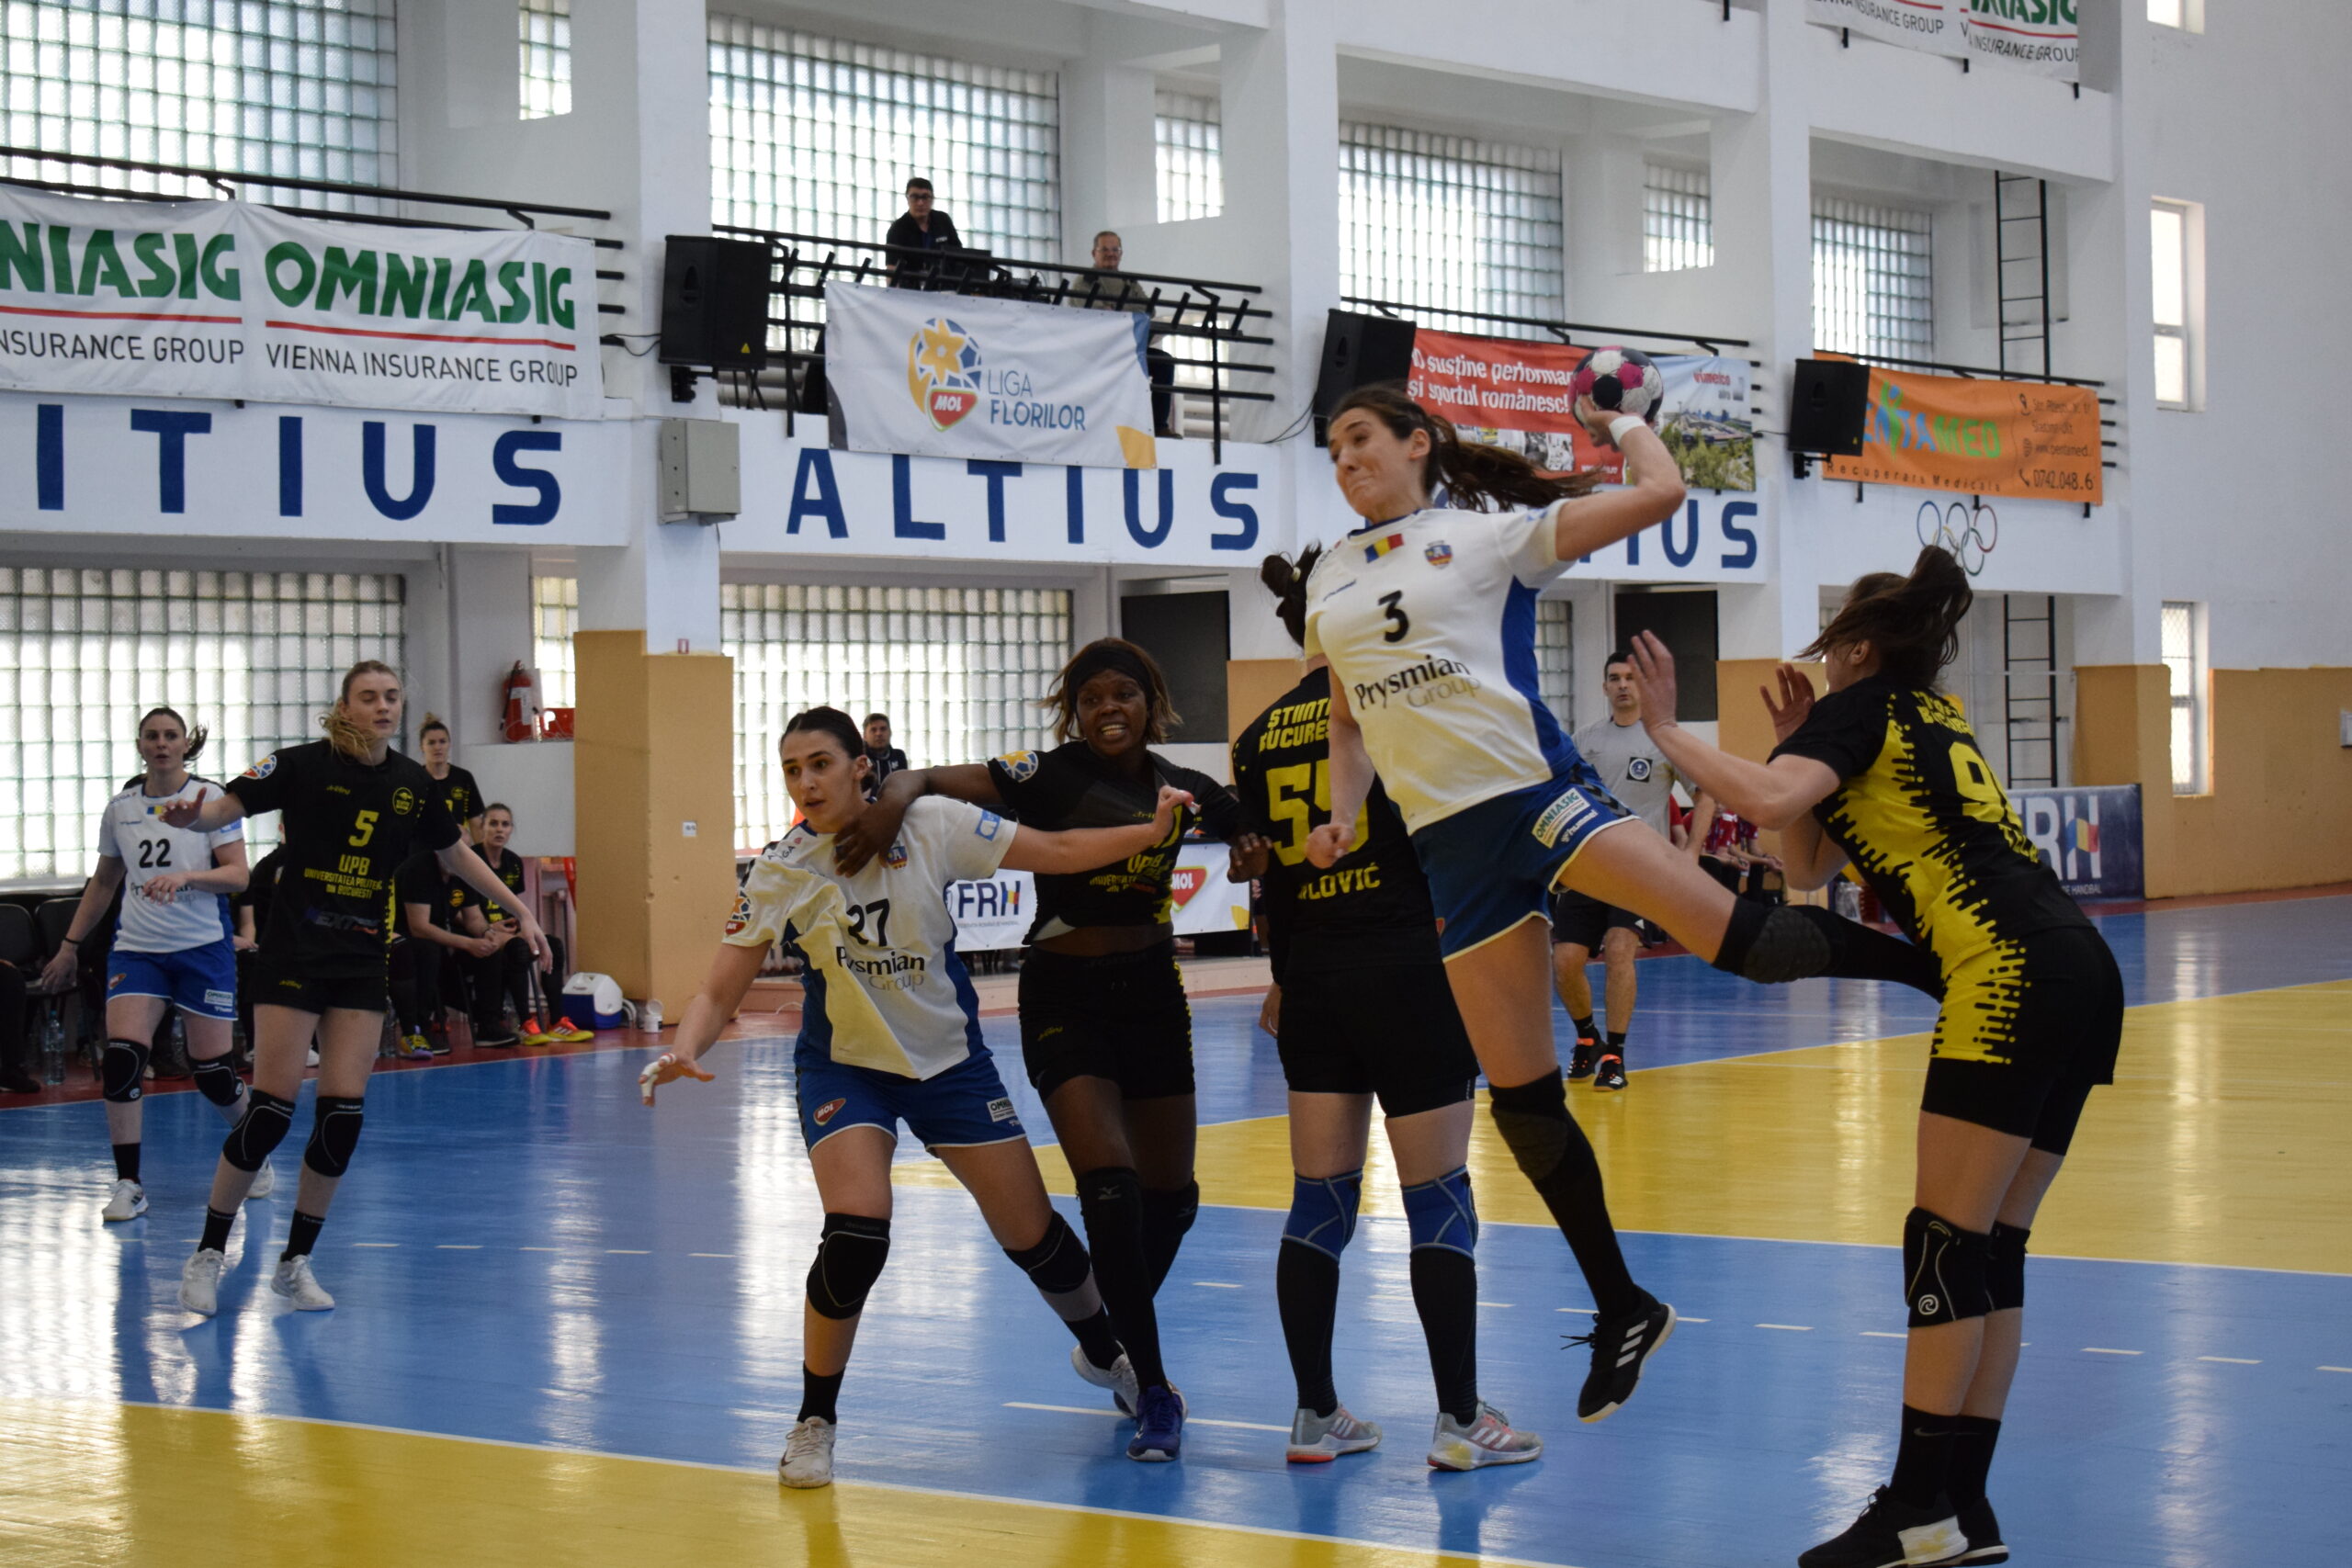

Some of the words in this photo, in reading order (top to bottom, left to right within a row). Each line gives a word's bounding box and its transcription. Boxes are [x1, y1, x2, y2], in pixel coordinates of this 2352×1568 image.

[1903, 13, 1944, 34] GROUP
[266, 241, 575, 331] OMNIASIG
[154, 336, 243, 364] GROUP
[266, 344, 356, 375] VIENNA
[363, 352, 502, 382] INSURANCE
[510, 359, 578, 388] GROUP
[988, 370, 1033, 398] LIGA
[1429, 384, 1478, 406] sportul
[1481, 389, 1569, 413] românesc!
[933, 395, 962, 412] MOL
[989, 400, 1086, 431] FLORILOR
[786, 447, 1259, 551] ALTIUS
[1378, 591, 1408, 642] 3
[1354, 654, 1471, 710] Prysmian
[1407, 677, 1482, 708] Group
[348, 809, 380, 847] 5
[1536, 793, 1579, 838] OMNIASIG
[139, 838, 172, 868] 22
[338, 853, 371, 876] UPB
[1126, 853, 1165, 874] UPB
[1171, 872, 1194, 890] MOL
[957, 880, 1021, 919] FRH
[846, 898, 890, 947] 27
[868, 974, 924, 992] Group
[817, 1102, 834, 1119] MOL
